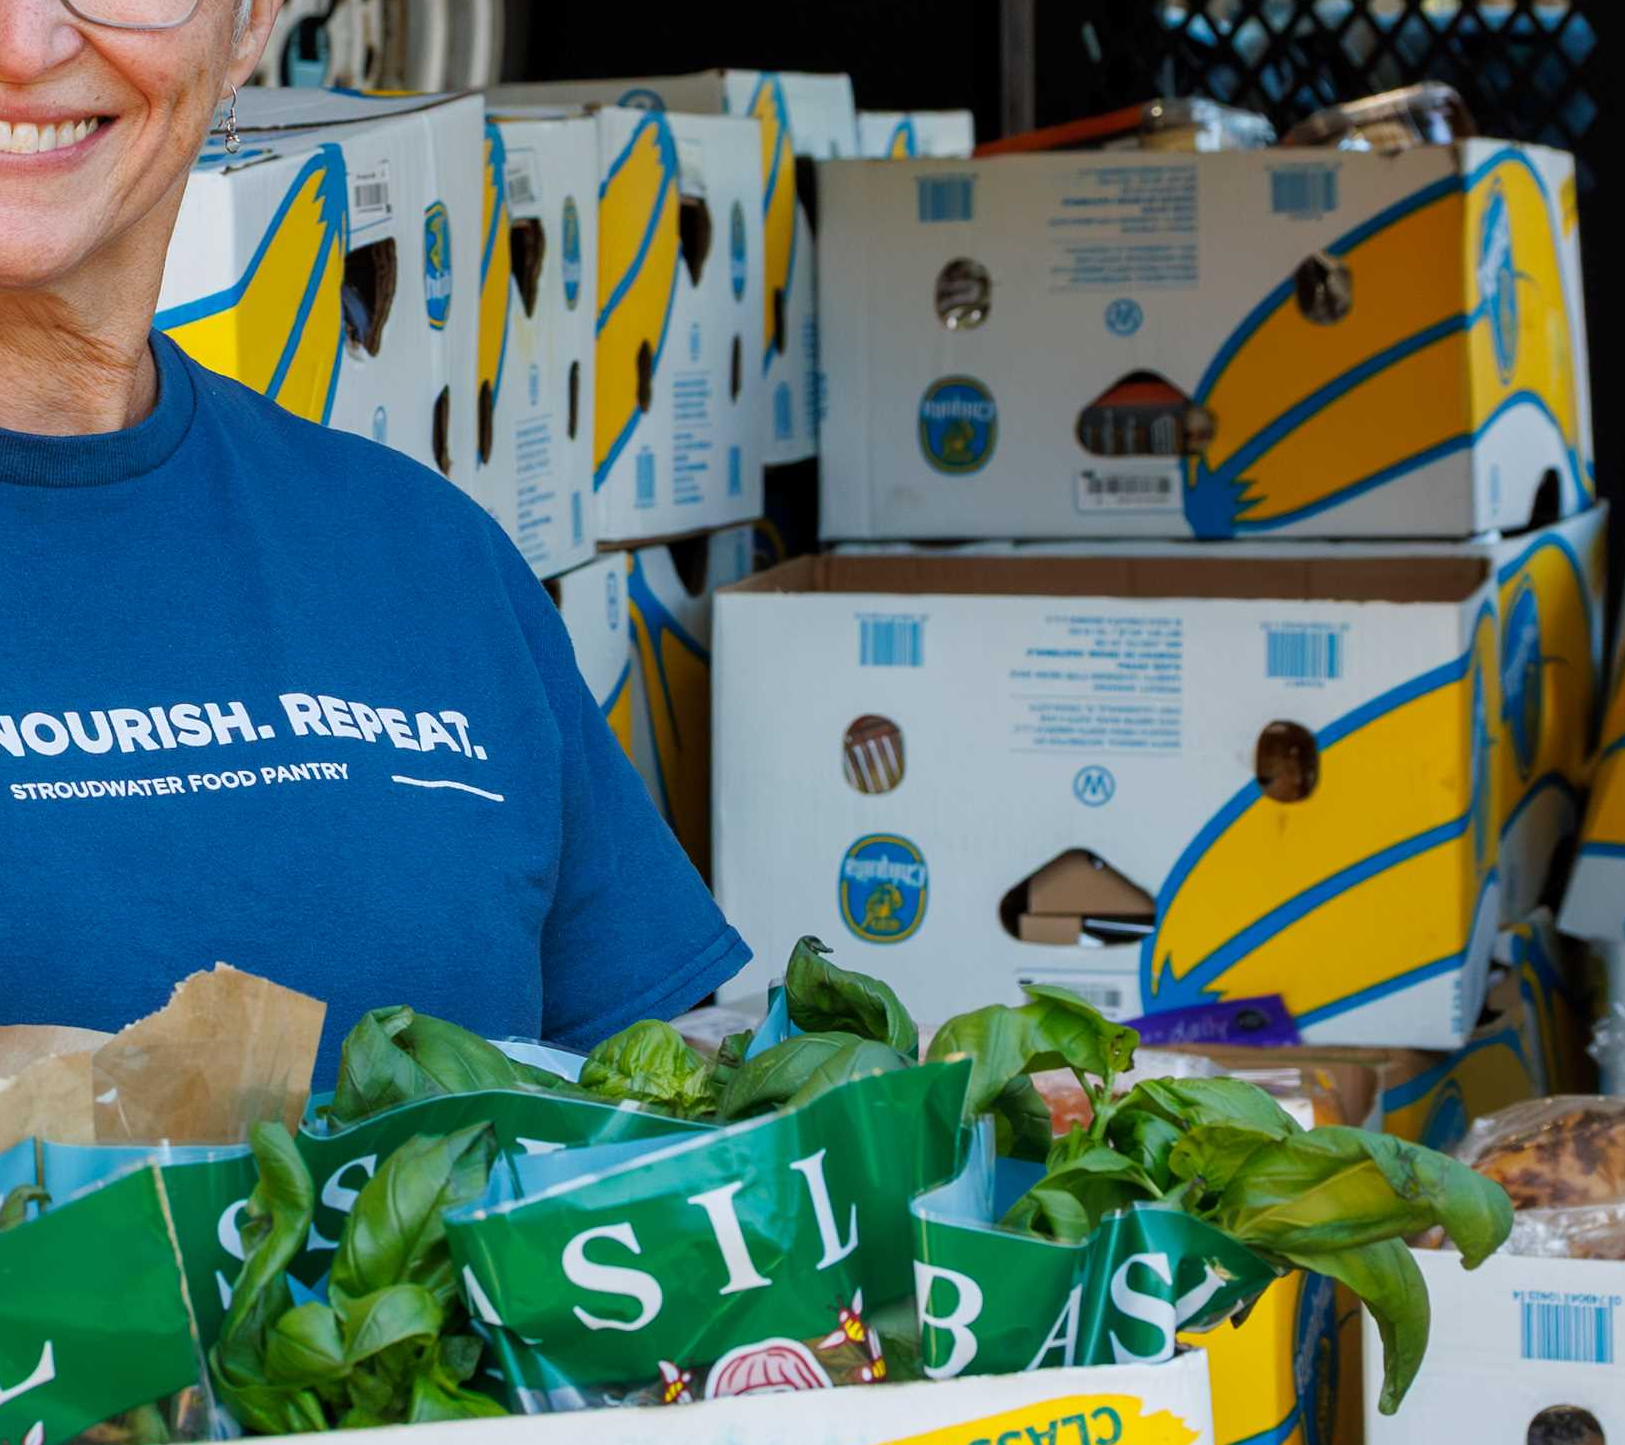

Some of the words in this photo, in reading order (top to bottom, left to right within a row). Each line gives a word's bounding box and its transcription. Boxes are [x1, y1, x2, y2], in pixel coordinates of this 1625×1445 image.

[279, 693, 487, 759] REPEAT.
[11, 777, 185, 800] STROUDWATER
[188, 771, 256, 792] FOOD
[261, 763, 348, 785] PANTRY
